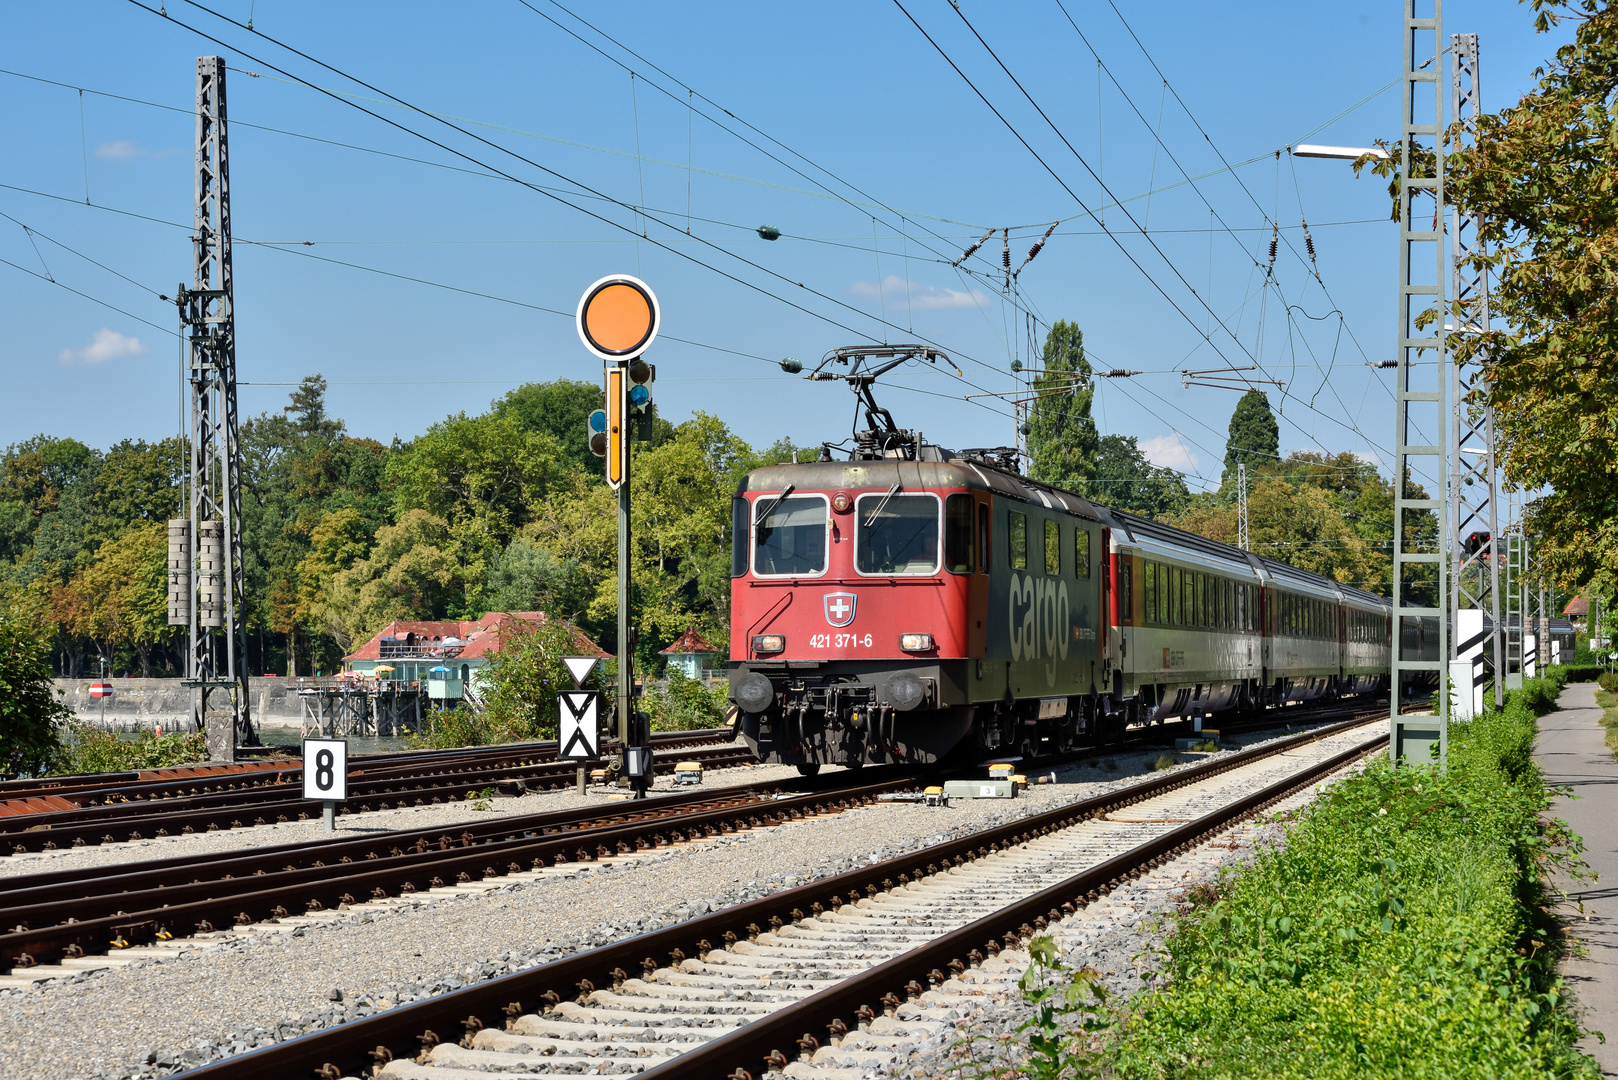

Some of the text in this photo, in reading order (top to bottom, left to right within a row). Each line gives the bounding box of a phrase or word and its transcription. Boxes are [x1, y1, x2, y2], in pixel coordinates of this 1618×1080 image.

[809, 633, 873, 648] 421 371-6
[1009, 572, 1069, 688] cargo
[315, 748, 334, 791] 8
[985, 787, 991, 795] 3
